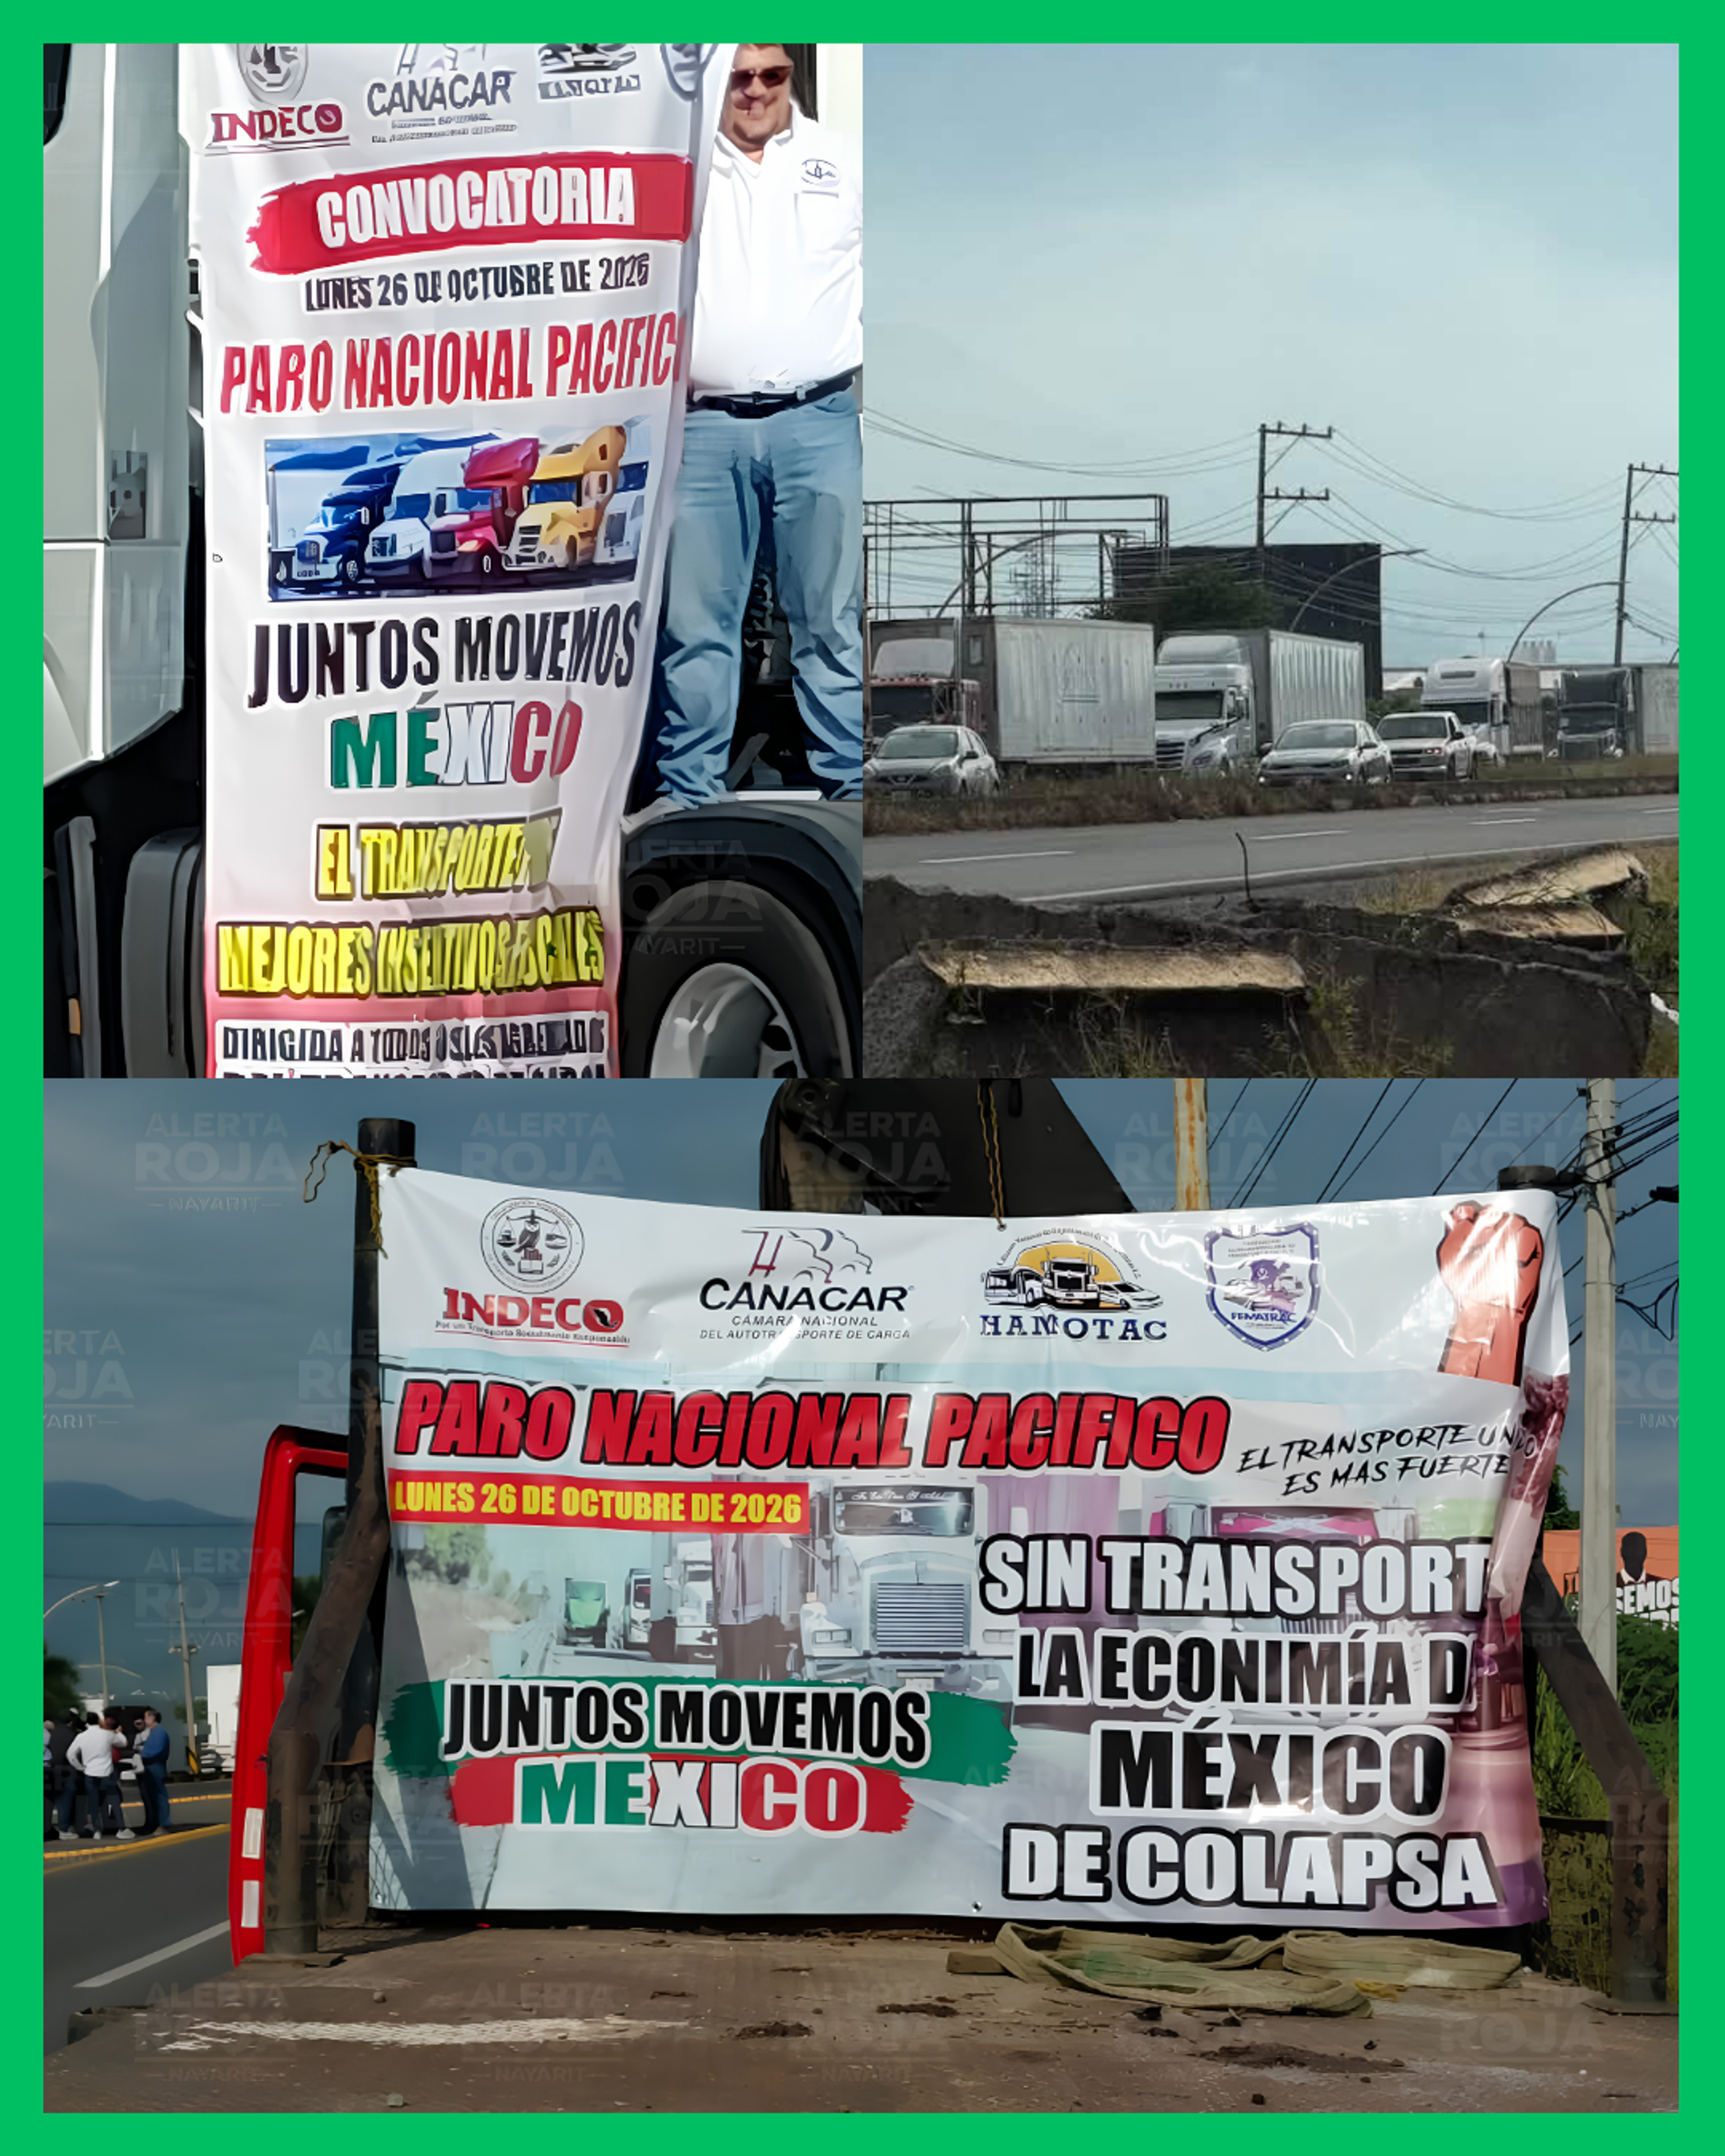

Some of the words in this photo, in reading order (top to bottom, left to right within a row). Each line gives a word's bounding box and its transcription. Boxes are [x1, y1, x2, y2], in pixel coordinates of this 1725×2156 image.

[211, 103, 342, 142] INDECO
[367, 71, 516, 116] CANACAR
[316, 166, 635, 248] CONVOCATORIA
[305, 276, 374, 311] LUNES
[378, 272, 407, 306] 26
[448, 262, 554, 302] OCTUBRE
[561, 259, 590, 292] DE
[221, 340, 333, 413] PARO
[345, 327, 533, 409] NACIONAL
[248, 616, 438, 708] JUNTOS
[455, 601, 641, 688] MOVEMOS
[331, 690, 583, 787] MÉXICO
[317, 826, 352, 896] EL
[219, 924, 374, 994] MEJORES
[223, 1027, 342, 1062] DIRIGIDA
[350, 1029, 364, 1062] A
[443, 1287, 624, 1333] INDECO
[699, 1277, 907, 1311] CANACAR
[801, 1316, 878, 1326] NACIONAL
[980, 1314, 1167, 1340] HAMOTAC
[700, 1330, 722, 1339] DEL
[727, 1330, 842, 1339] AUTOTRSPORTE
[846, 1330, 862, 1339] DE
[394, 1379, 575, 1460] PARO
[581, 1389, 912, 1469] NACIONAL
[924, 1392, 1231, 1474] PACIFICO
[1236, 1446, 1278, 1473] EL
[1279, 1423, 1477, 1471] TRANSPORTE
[395, 1481, 474, 1513] LUNES
[481, 1483, 517, 1515] 26
[522, 1485, 555, 1516] DE
[562, 1487, 684, 1521] OCTUBRE
[691, 1493, 725, 1523] DE
[730, 1493, 802, 1524] 2026
[1282, 1471, 1321, 1496] ES
[1331, 1460, 1389, 1489] MAS
[1395, 1454, 1509, 1481] FUERTE
[982, 1536, 1089, 1613] SIN
[1016, 1633, 1084, 1698] LA
[1100, 1630, 1411, 1705] ECONIMÍA
[445, 1684, 642, 1754] JUNTOS
[661, 1689, 927, 1760] MOVEMOS
[520, 1760, 862, 1833] MEXICO
[1100, 1717, 1445, 1816] MÉXICO
[1005, 1826, 1108, 1899] DE
[1122, 1829, 1502, 1909] COLAPSA
